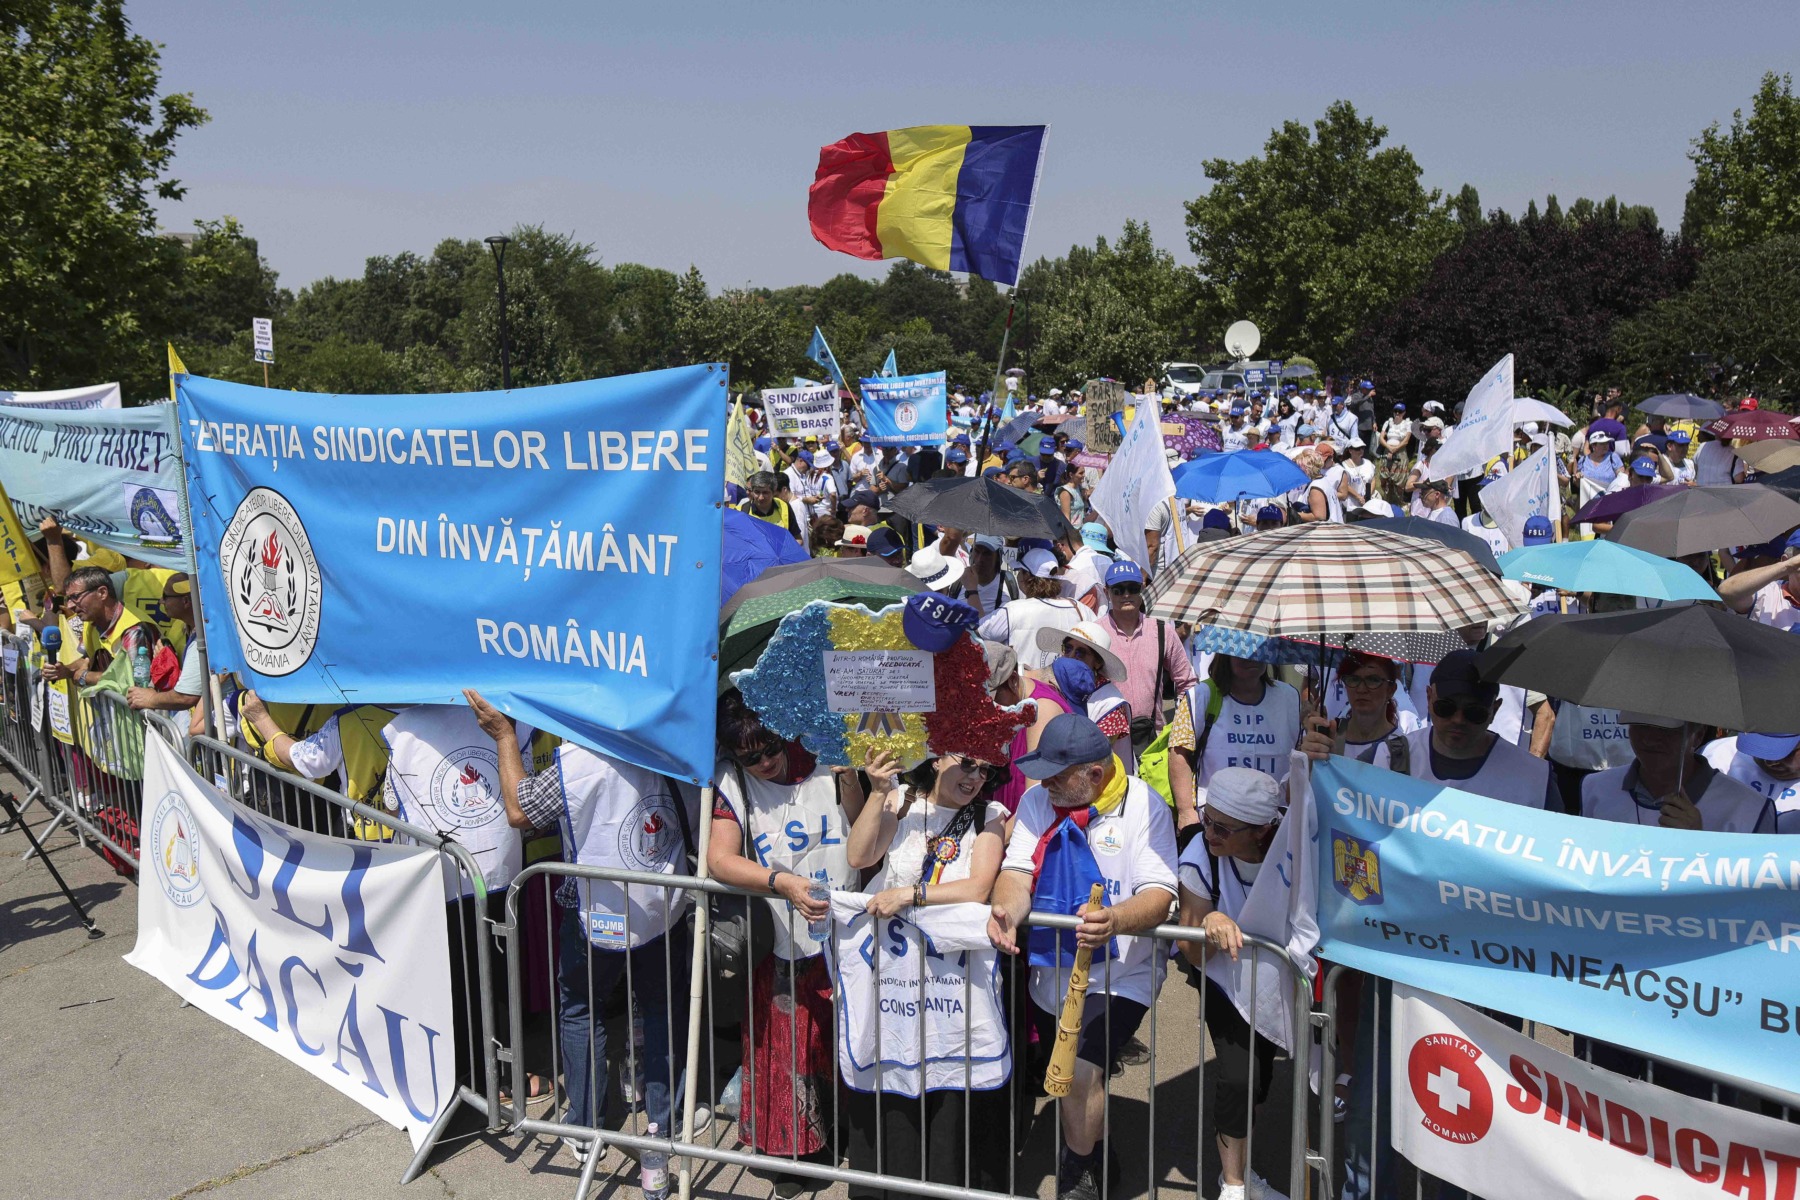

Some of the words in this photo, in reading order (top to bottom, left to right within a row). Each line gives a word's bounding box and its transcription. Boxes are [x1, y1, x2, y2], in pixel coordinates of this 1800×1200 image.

[10, 399, 103, 410] NDICATELOR
[768, 390, 835, 405] SINDICATUL
[867, 386, 940, 401] VRANCEA
[801, 418, 834, 430] BRAȘO
[189, 418, 306, 472] FEDERAȚIA
[313, 424, 550, 471] SINDICATELOR
[564, 428, 710, 472] LIBERE
[376, 515, 429, 557] DIN
[438, 512, 679, 583] ÎNVĂȚĂMÂNT
[1114, 565, 1134, 574] FSLI
[919, 596, 964, 624] FSLI
[475, 617, 648, 678] ROMÂNIA
[1227, 733, 1275, 745] BUZAU
[1333, 786, 1545, 862] SINDICATUL
[1556, 838, 1800, 891] ÎNVĂȚĂMÂ
[592, 919, 624, 931] DGJMB
[1438, 880, 1800, 954] PREUNIVERSITAR
[873, 976, 907, 989] INDICAT
[1471, 938, 1538, 974] ION
[1760, 998, 1800, 1038] B
[880, 997, 964, 1019] CONSTANȚA
[1424, 1036, 1477, 1058] SANITAS
[1424, 1116, 1479, 1142] ROMANIA
[1506, 1053, 1800, 1200] SINDICAT
